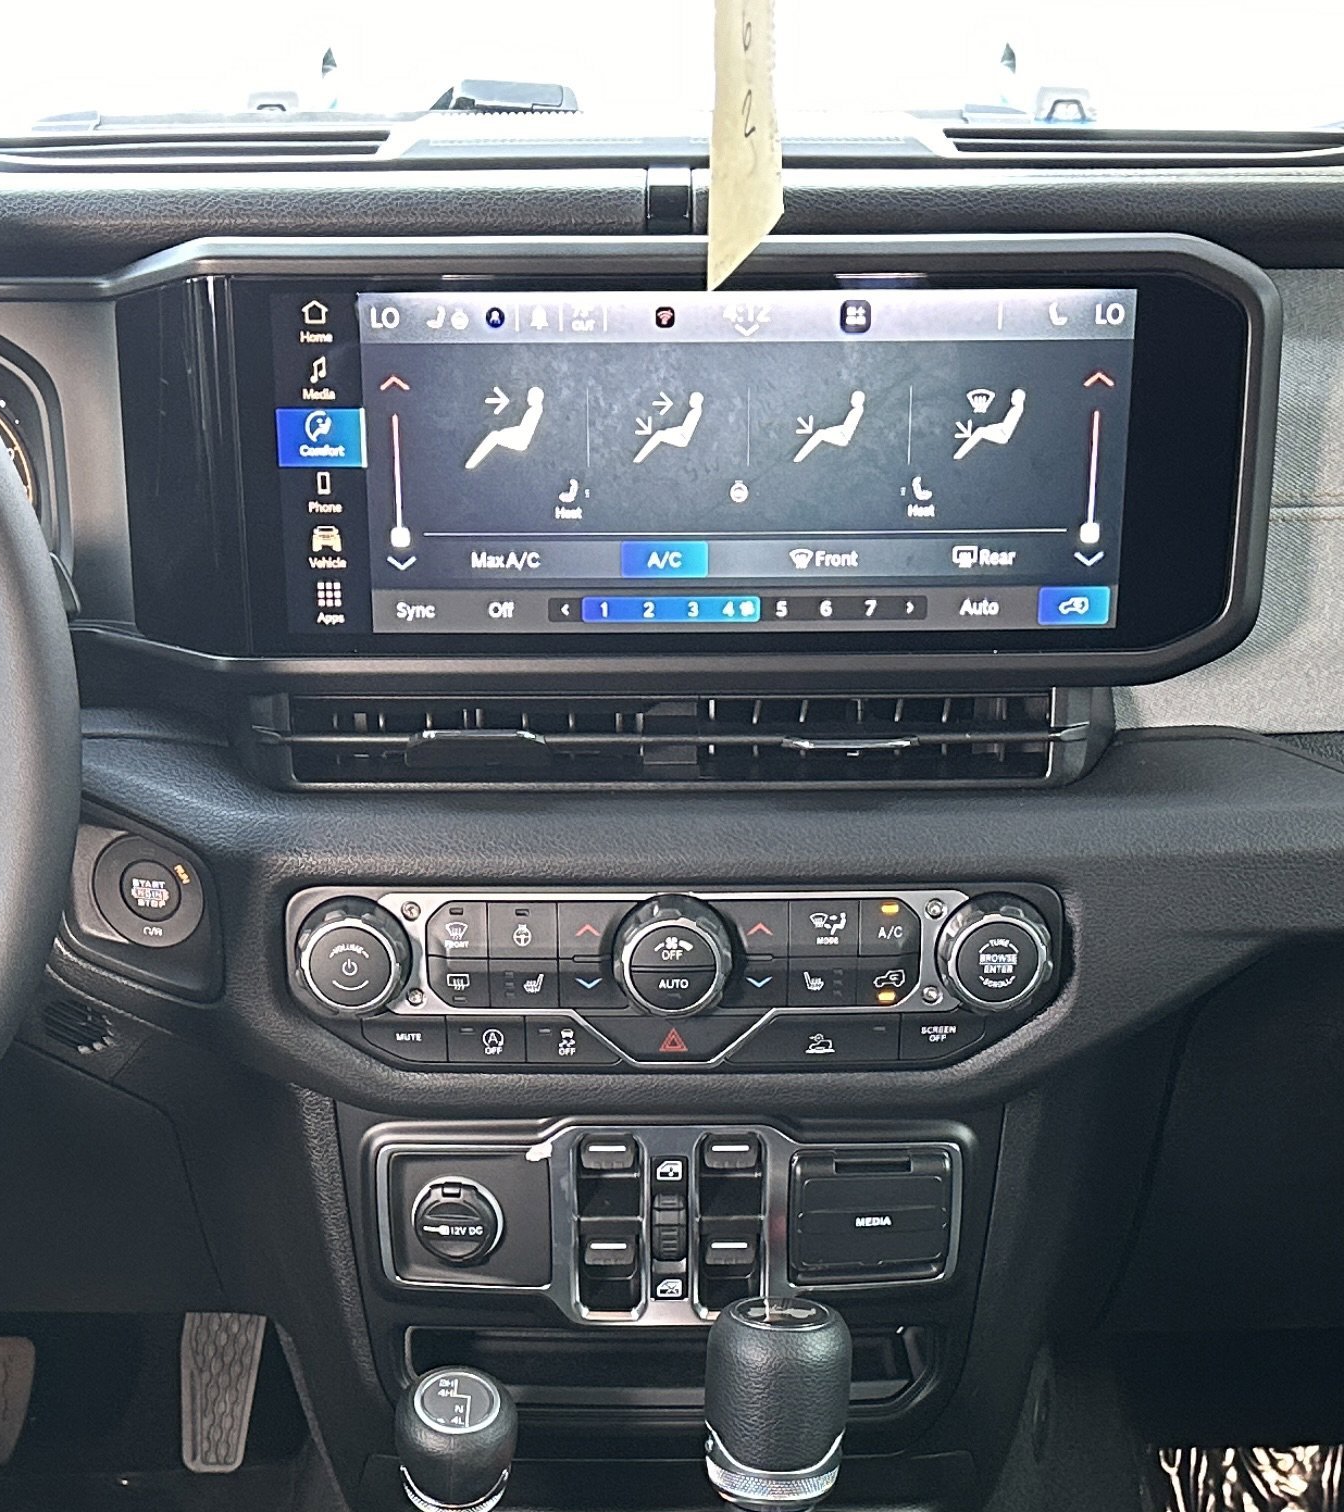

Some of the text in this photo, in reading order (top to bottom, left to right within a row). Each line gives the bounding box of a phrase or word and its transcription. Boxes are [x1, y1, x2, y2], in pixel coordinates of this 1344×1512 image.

[370, 309, 400, 328] LO
[1094, 304, 1125, 325] LO
[299, 331, 334, 344] Home
[302, 388, 336, 400] Media
[299, 445, 345, 458] Comfort
[307, 502, 343, 514] Phone
[308, 557, 347, 569] Vehicle
[470, 552, 541, 570] Max A/C
[647, 551, 682, 569] A/C
[815, 550, 859, 568] Front
[979, 550, 1017, 566] Rear
[396, 602, 436, 619] Sync
[488, 602, 514, 618] Off
[599, 600, 876, 618] 1 2 3 4 5 6 7
[959, 600, 999, 617] Auto
[316, 612, 346, 625] Apps
[878, 926, 904, 941] A/C
[662, 950, 684, 961] OFF
[659, 978, 689, 989] AUTO
[396, 1032, 422, 1042] MUTE
[921, 1026, 956, 1035] SCREEN
[485, 1047, 503, 1055] OFF
[559, 1047, 576, 1056] OFF
[856, 1216, 892, 1227] MEDIA
[450, 1225, 467, 1236] 12V
